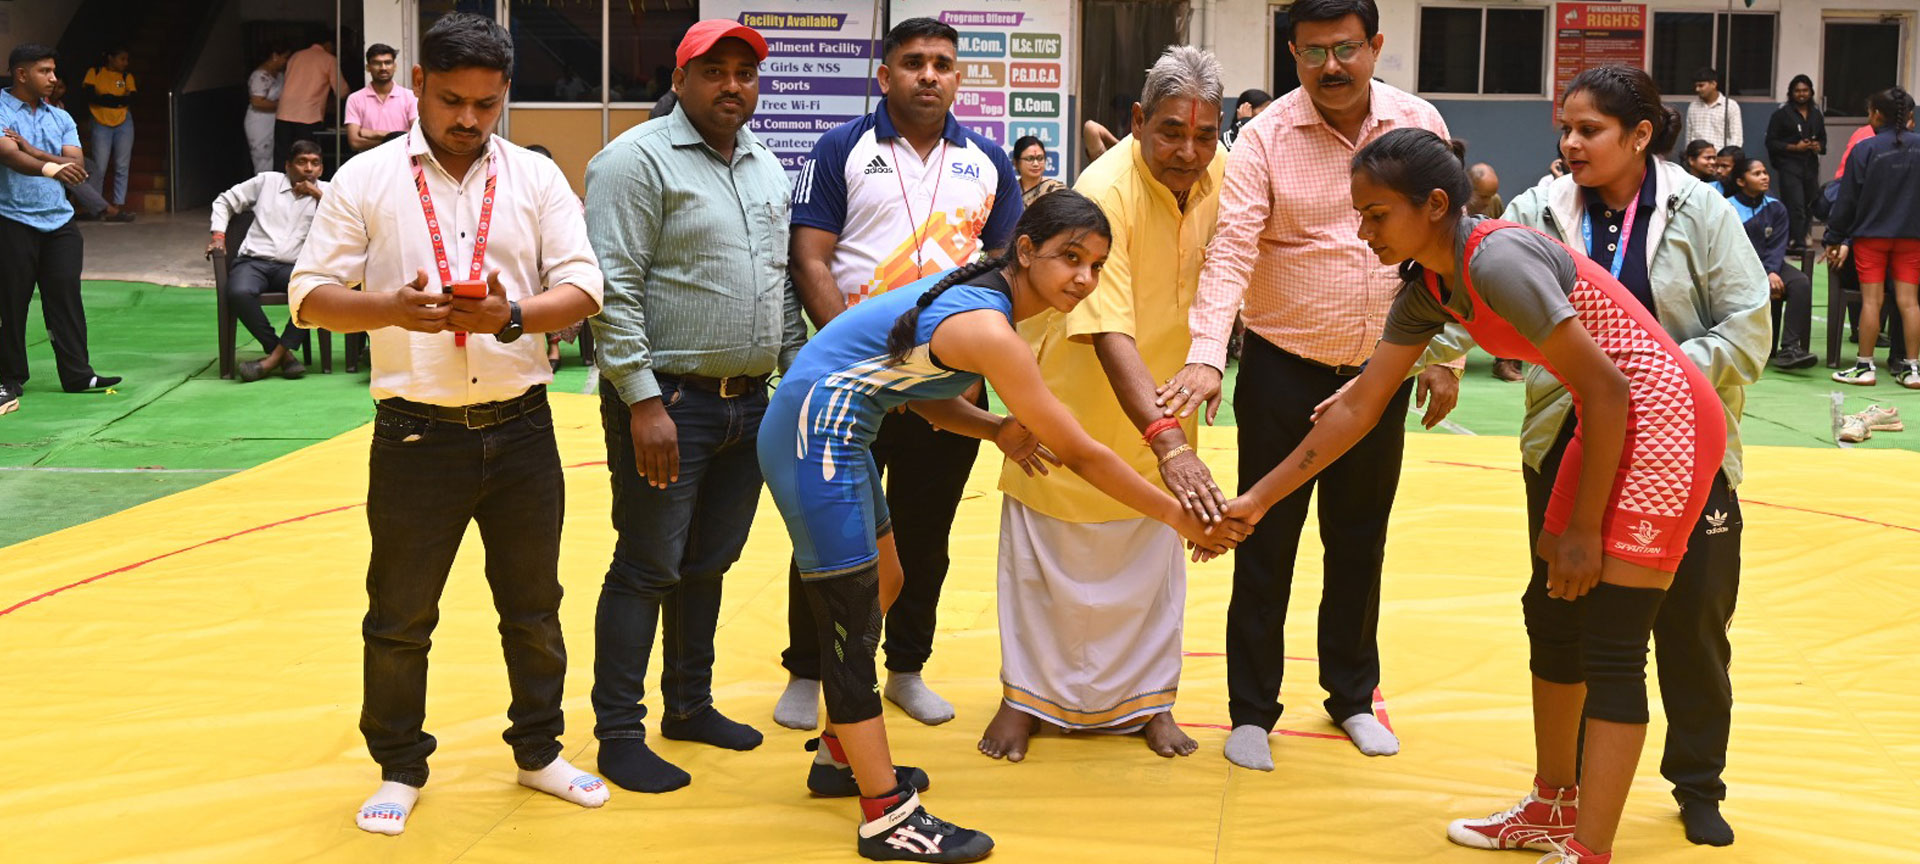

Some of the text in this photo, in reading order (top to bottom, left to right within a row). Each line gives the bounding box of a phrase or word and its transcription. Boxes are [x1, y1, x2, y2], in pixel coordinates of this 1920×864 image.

[1586, 5, 1640, 13] FUNDAMENTAL
[744, 14, 838, 28] Facility Available
[945, 13, 1017, 24] Programs Offered
[1586, 13, 1640, 27] RIGHTS
[767, 42, 862, 56] allment Facility
[958, 37, 1003, 52] M.Com.
[1011, 38, 1033, 53] M.Sc.
[770, 62, 799, 73] Girls
[802, 62, 813, 73] &
[817, 62, 841, 73] NSS
[967, 64, 993, 79] M.A.
[1012, 68, 1059, 83] P.G.D.C.A.
[771, 80, 811, 92] Sports
[761, 100, 821, 111] Free Wi-Fi
[956, 92, 980, 106] PGD
[1014, 98, 1055, 113] B.Com.
[980, 103, 1003, 116] Yoga
[764, 118, 812, 130] Common
[766, 138, 816, 148] Canteen
[864, 167, 893, 175] adidas
[1705, 526, 1729, 536] adidas
[1614, 541, 1661, 554] SPARTAN
